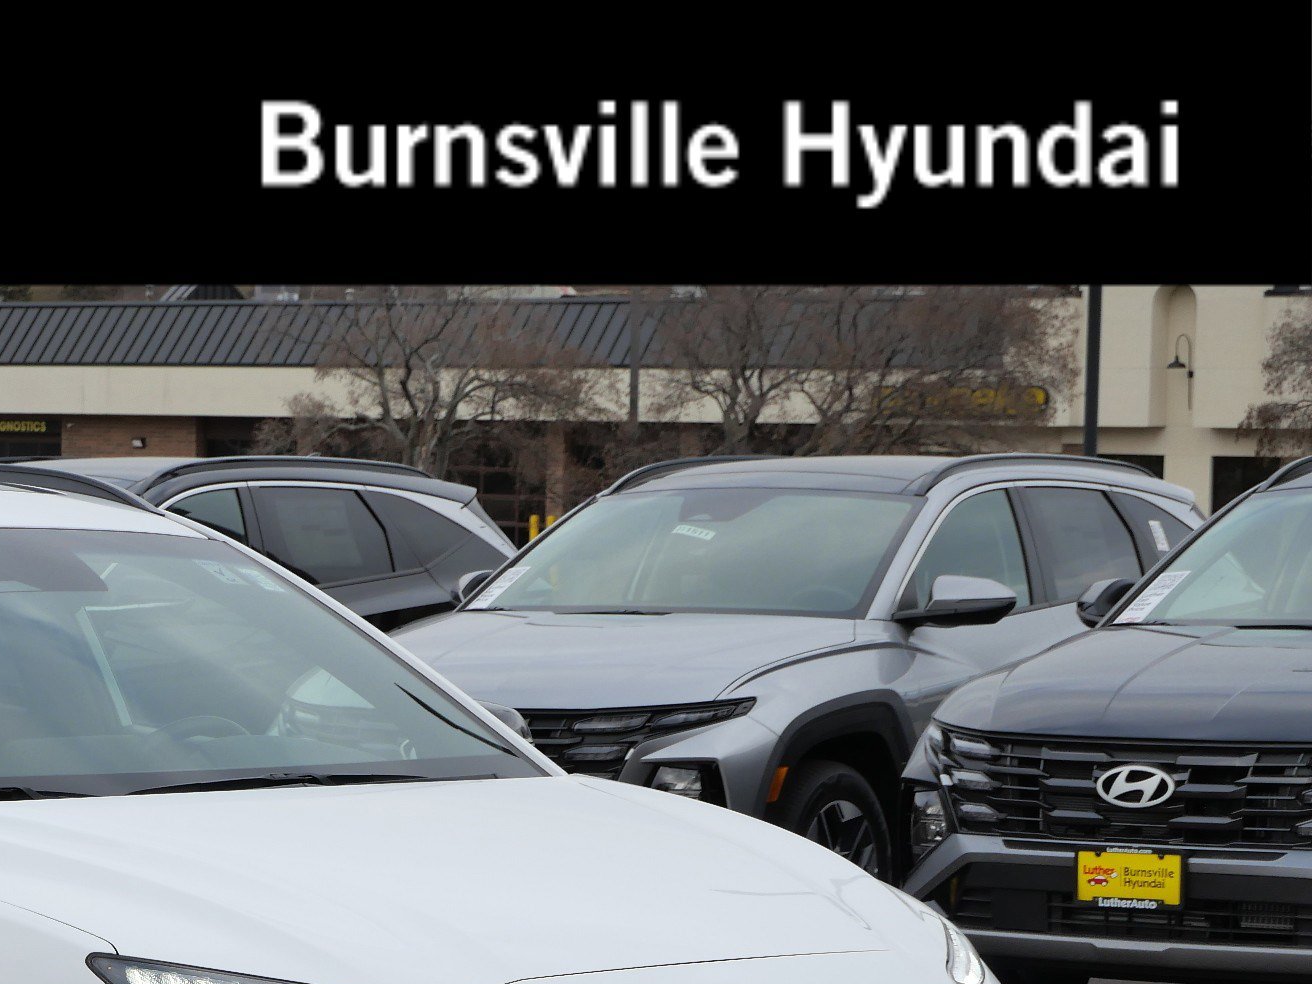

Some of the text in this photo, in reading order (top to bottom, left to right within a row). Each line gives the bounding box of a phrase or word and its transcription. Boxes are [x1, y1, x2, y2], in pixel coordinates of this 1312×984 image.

[1083, 864, 1115, 876] Luther
[1123, 866, 1175, 879] Burnsville
[1123, 877, 1165, 889] Hyundai
[1098, 897, 1158, 909] LutherAuto
